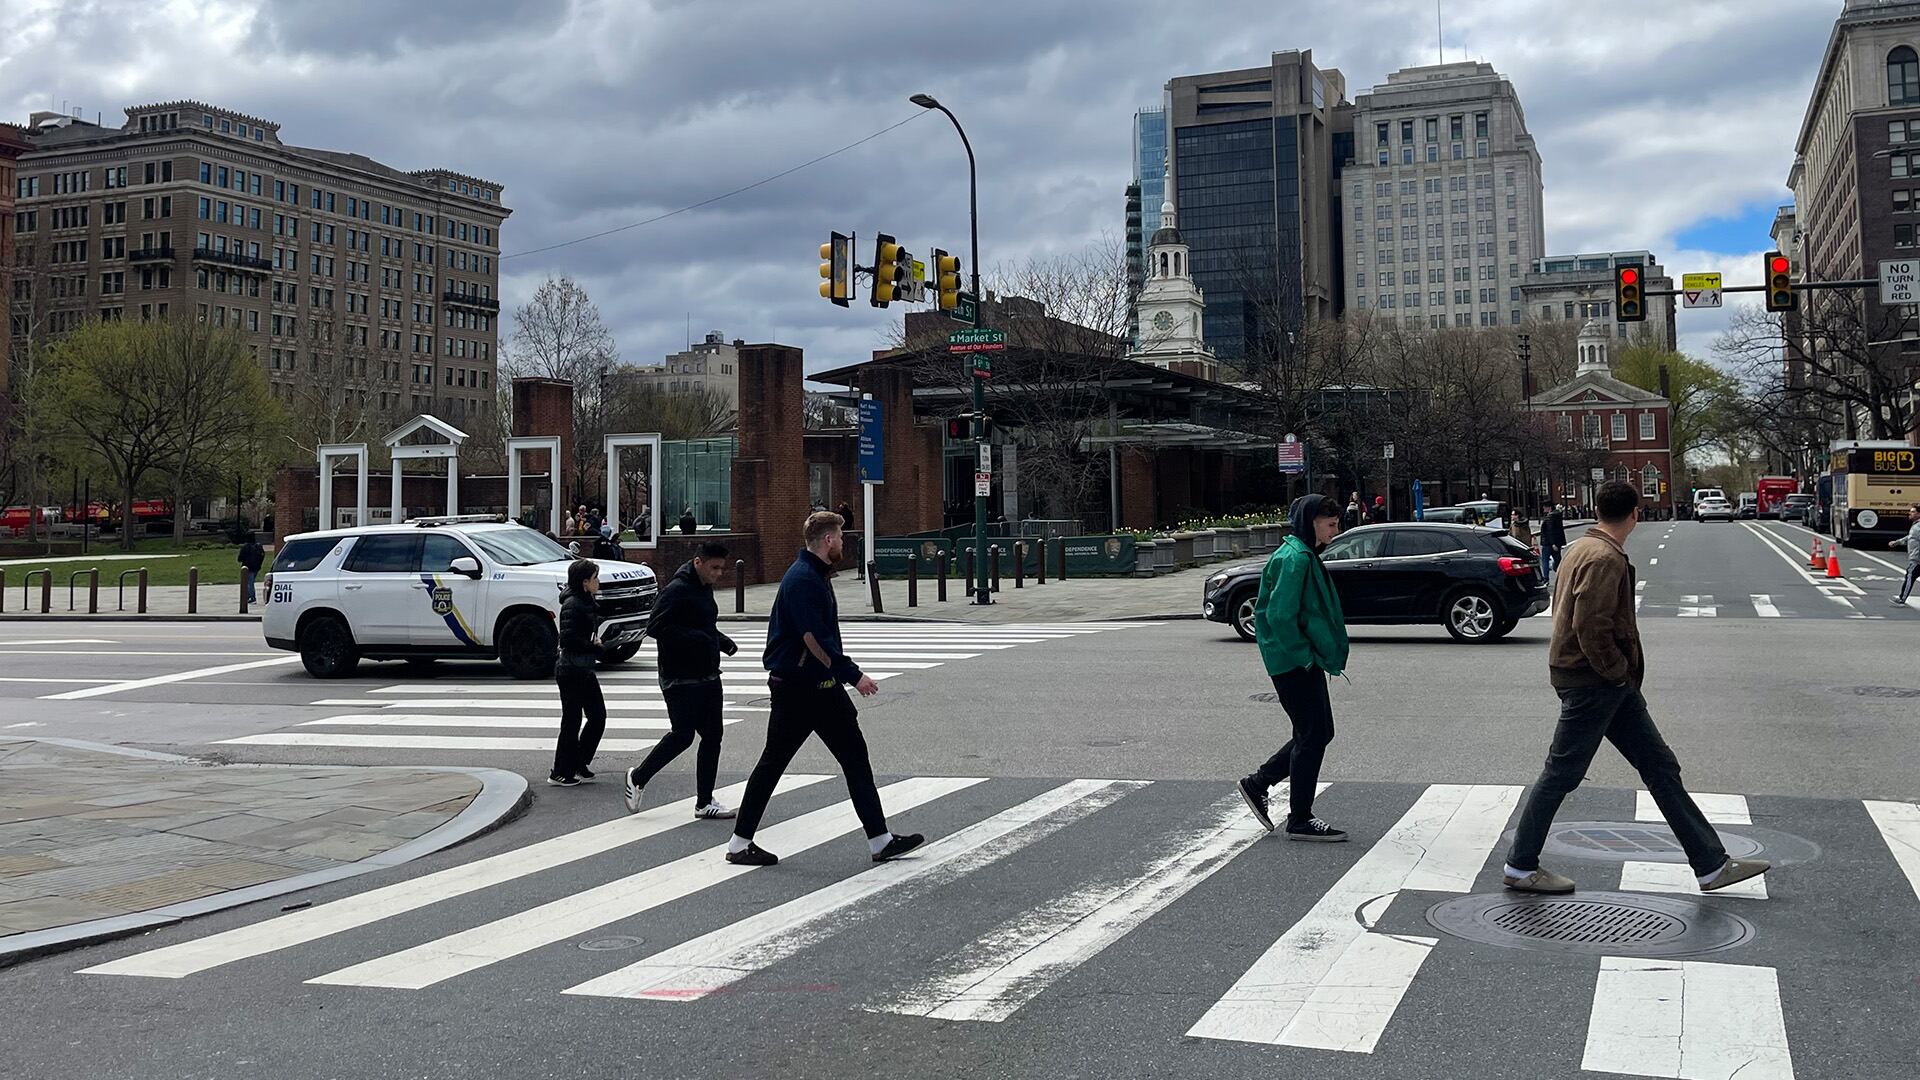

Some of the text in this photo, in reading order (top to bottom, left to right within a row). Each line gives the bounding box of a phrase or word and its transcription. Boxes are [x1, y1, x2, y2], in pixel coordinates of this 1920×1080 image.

[1890, 263, 1910, 274] NO
[1887, 275, 1914, 283] TURN
[1891, 292, 1912, 300] RED
[956, 333, 989, 343] Market
[992, 333, 1002, 341] St
[1874, 451, 1896, 461] BIG
[1874, 461, 1897, 471] BUS
[611, 569, 648, 580] POLICE
[274, 591, 293, 603] 911
